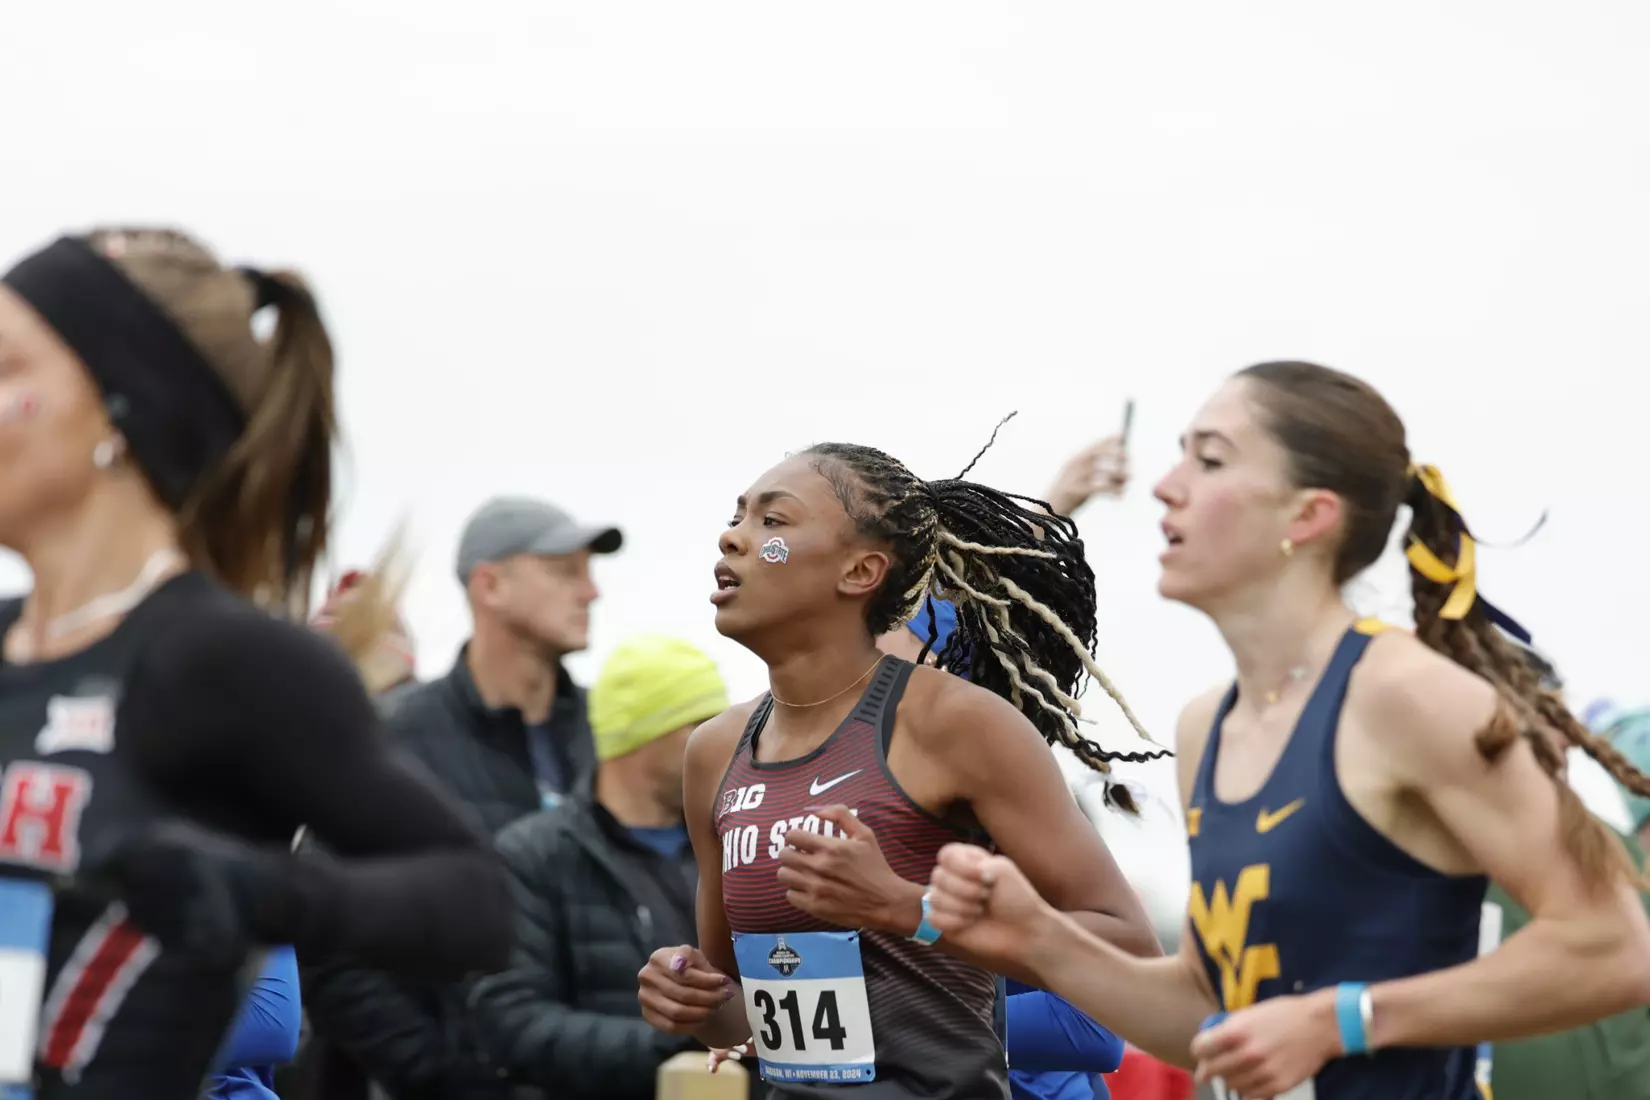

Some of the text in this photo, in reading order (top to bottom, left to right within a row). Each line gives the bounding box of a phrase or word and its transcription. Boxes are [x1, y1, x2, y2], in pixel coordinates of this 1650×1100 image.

[722, 824, 759, 875] HIO
[754, 989, 847, 1050] 314
[796, 1069, 829, 1080] NOVEMBER
[842, 1067, 861, 1079] 2024
